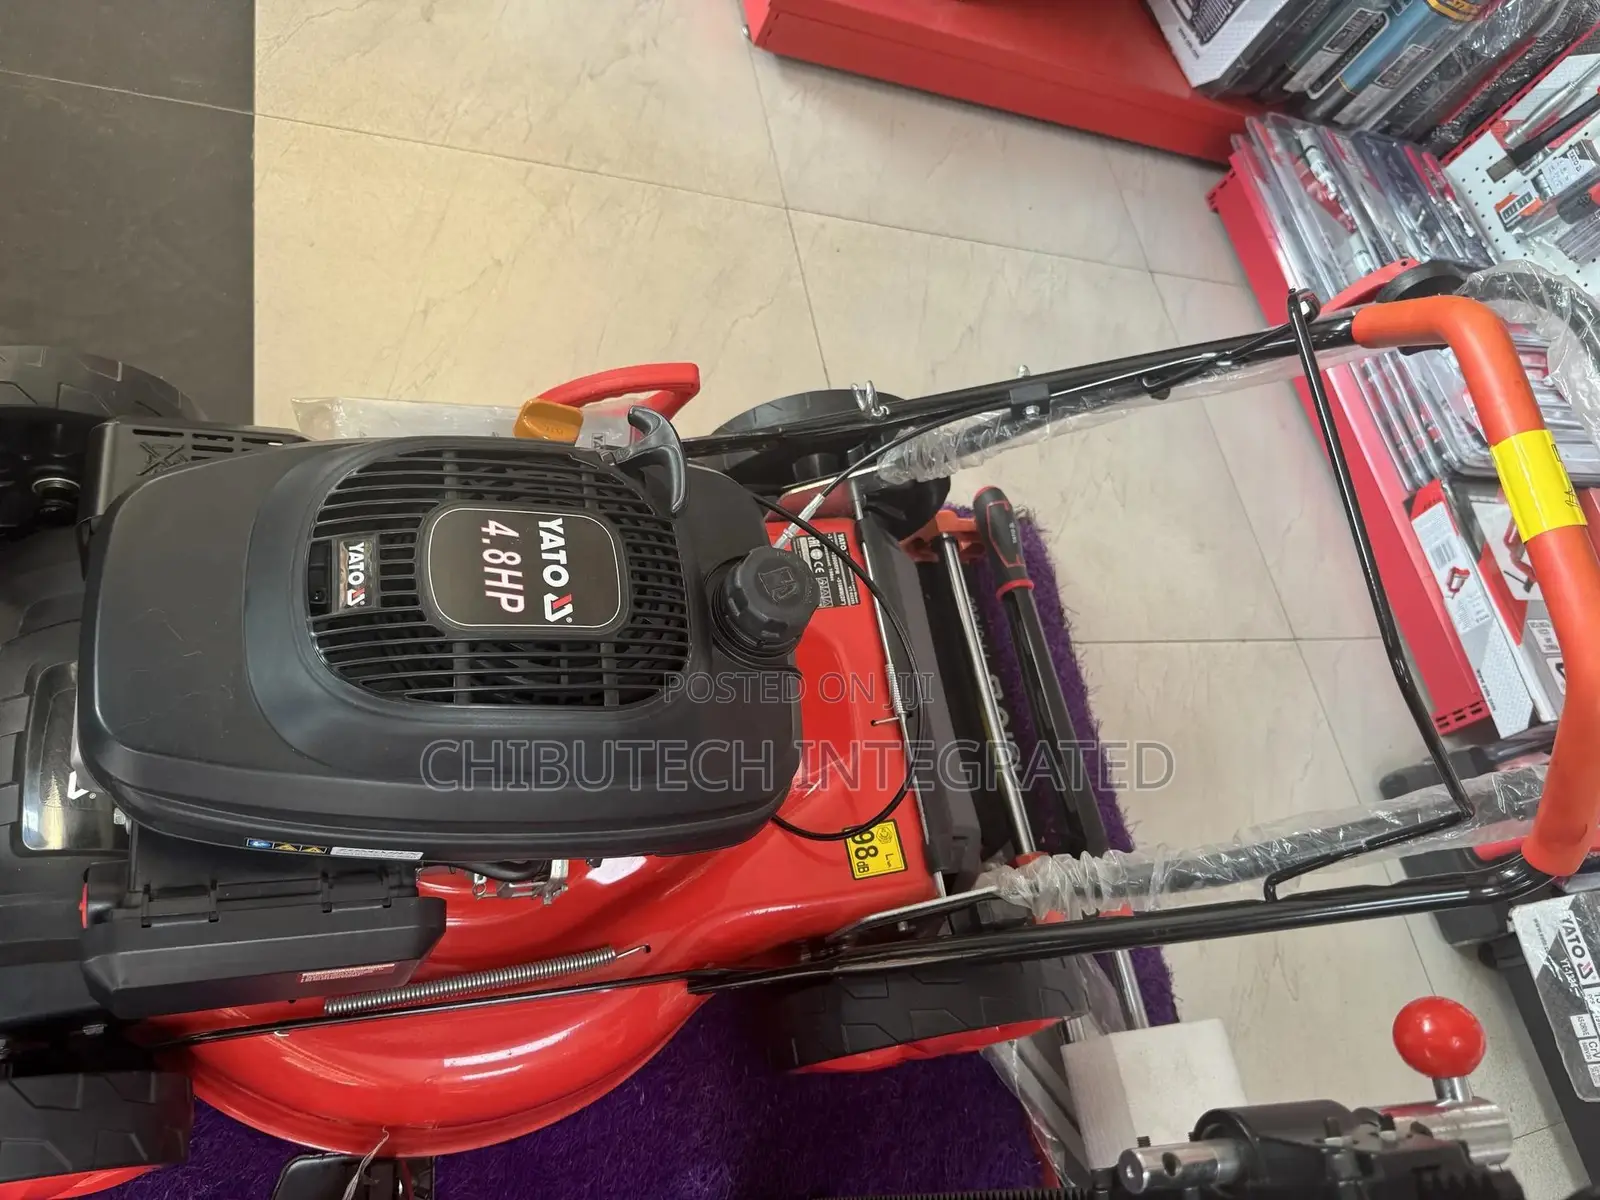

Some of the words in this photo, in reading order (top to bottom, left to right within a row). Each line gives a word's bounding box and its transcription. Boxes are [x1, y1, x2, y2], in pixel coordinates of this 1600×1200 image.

[538, 517, 570, 588] YATO
[838, 533, 847, 551] YATO
[347, 541, 366, 586] YATO
[480, 519, 525, 614] 4.8HP
[813, 561, 825, 573] CE
[851, 831, 879, 860] 98
[857, 862, 869, 874] dB
[1560, 915, 1586, 957] YATO
[1588, 1040, 1600, 1059] CrV
